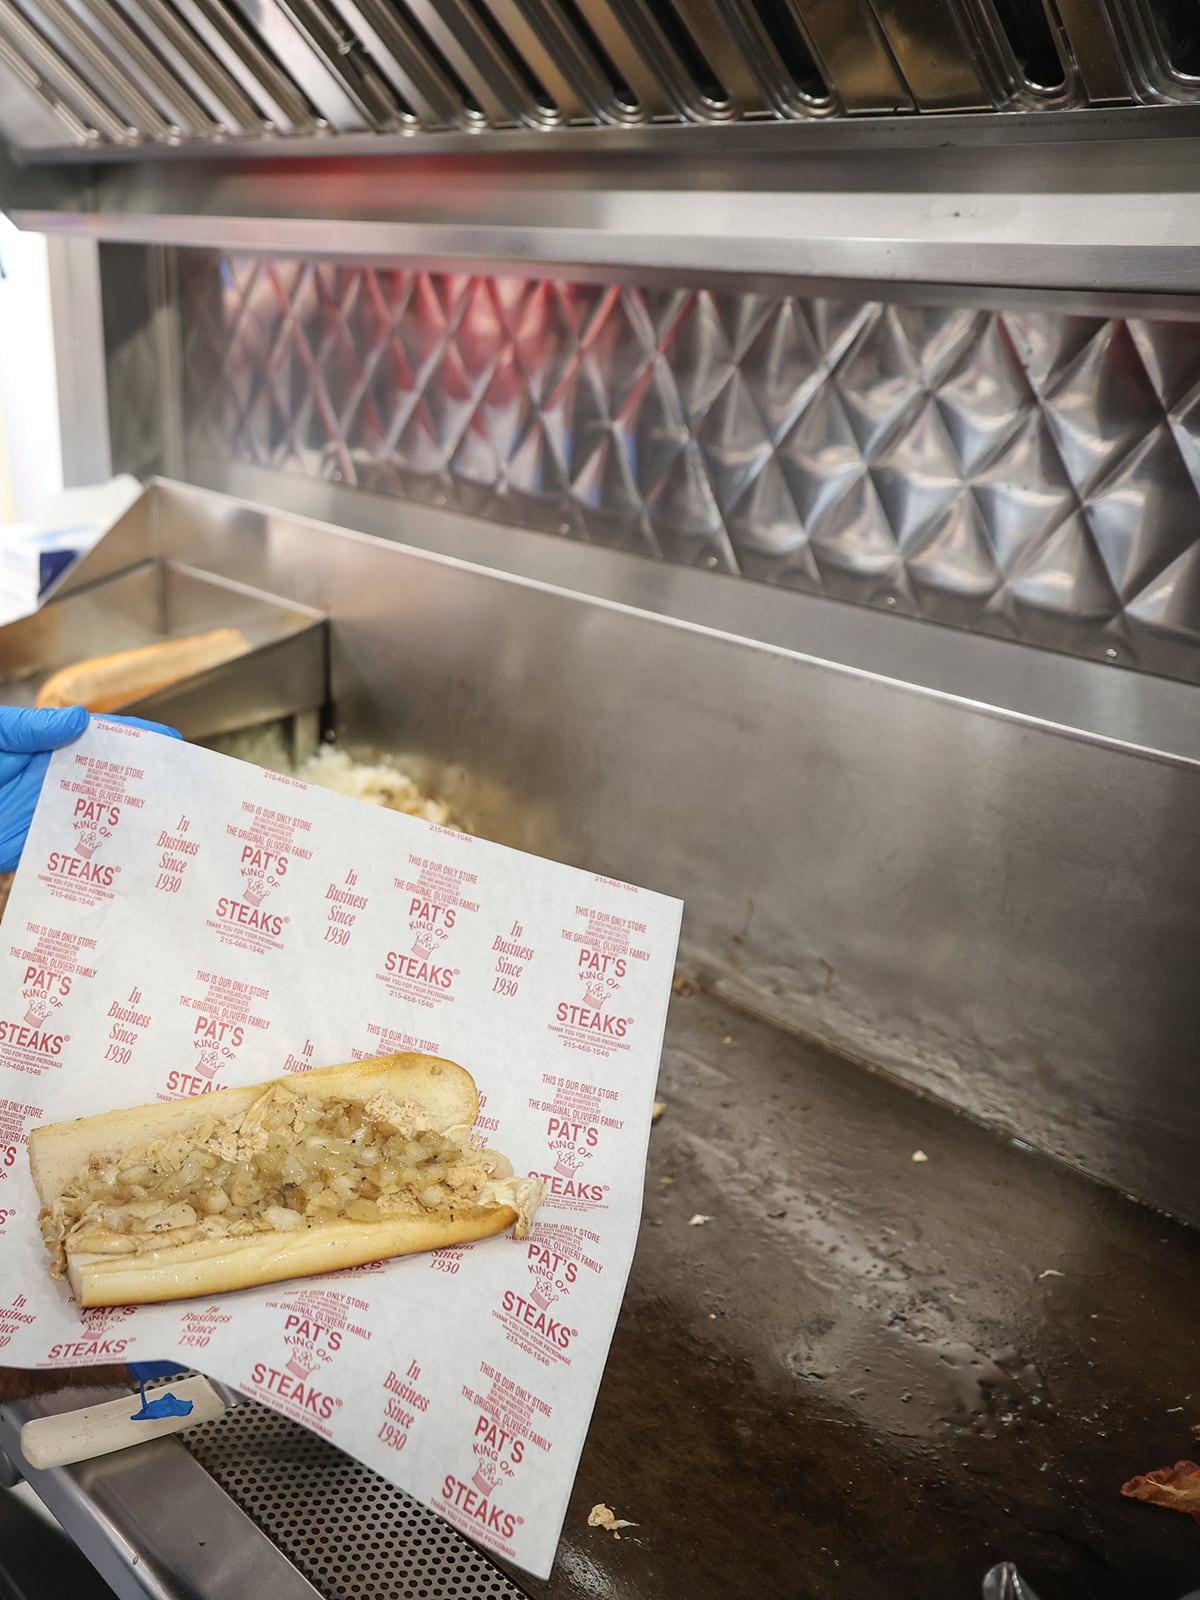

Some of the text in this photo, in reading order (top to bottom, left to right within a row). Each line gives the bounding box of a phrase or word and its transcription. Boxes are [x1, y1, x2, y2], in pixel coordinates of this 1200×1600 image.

[74, 798, 120, 826] PAT'S
[176, 814, 190, 832] In
[73, 821, 112, 839] KING OF
[156, 830, 200, 856] Business
[159, 852, 187, 873] Since
[241, 845, 288, 876] PAT'S
[409, 854, 422, 866] THIS
[422, 859, 429, 868] IS
[429, 861, 442, 872] OUR
[442, 865, 458, 877] ONLY
[458, 870, 479, 884] STORE
[154, 873, 182, 892] 1930
[241, 868, 280, 888] KING OF
[345, 869, 358, 886] In
[325, 883, 368, 910] Business
[394, 878, 406, 890] THE
[405, 882, 433, 898] ORIGINAL
[432, 890, 459, 906] OLIVIERI
[457, 898, 480, 912] FAMILY
[328, 905, 356, 926] Since
[409, 898, 456, 928] PAT'S
[26, 922, 97, 949] THIS IS OUR ONLY STORE
[323, 926, 351, 945] 1930
[409, 921, 449, 941] KING OF
[510, 920, 523, 937] In
[492, 935, 534, 960] Business
[10, 947, 22, 958] THE
[21, 950, 49, 965] ORIGINAL
[49, 958, 76, 972] OLIVIERI
[74, 964, 97, 978] FAMILY
[495, 956, 523, 977] Since
[579, 949, 627, 978] PAT'S
[24, 966, 72, 996] PAT'S
[196, 971, 270, 999] THIS IS OUR ONLY STORE
[492, 977, 518, 996] 1930
[579, 971, 621, 990] KING OF
[22, 989, 63, 1009] KING OF
[128, 986, 142, 1004] In
[107, 1001, 151, 1028] Business
[180, 996, 192, 1007] THE
[191, 999, 221, 1015] ORIGINAL
[220, 1007, 248, 1023] OLIVIERI
[246, 1015, 271, 1029] FAMILY
[109, 1022, 138, 1045] Since
[194, 1016, 244, 1047] PAT'S
[367, 1023, 440, 1053] THIS IS OUR ONLY STORE
[104, 1044, 132, 1064] 1930
[193, 1040, 236, 1059] KING OF
[302, 1039, 314, 1057] In
[542, 1074, 556, 1085] THIS
[557, 1078, 565, 1087] IS
[565, 1080, 579, 1091] OUR
[580, 1083, 596, 1095] ONLY
[597, 1087, 619, 1101] STORE
[7, 1100, 23, 1113] ONLY
[23, 1105, 44, 1119] STORE
[528, 1099, 541, 1109] THE
[541, 1102, 571, 1116] ORIGINAL
[571, 1109, 600, 1124] OLIVIERI
[599, 1116, 624, 1129] FAMILY
[547, 1118, 599, 1147] PAT'S
[548, 1140, 593, 1159] KING OF
[430, 1260, 460, 1274] 1930
[528, 1244, 578, 1283] PAT'S
[528, 1265, 569, 1295] KING OF
[12, 1294, 27, 1308] In
[327, 1292, 345, 1304] ONLY
[347, 1297, 370, 1311] STORE
[285, 1314, 343, 1351] PAT'S
[284, 1336, 334, 1363] KING OF
[406, 1359, 421, 1380] In
[383, 1370, 430, 1412] Business
[480, 1361, 494, 1379] THIS
[494, 1370, 502, 1384] IS
[501, 1375, 515, 1393] OUR
[515, 1384, 531, 1403] ONLY
[531, 1395, 553, 1417] STORE
[384, 1397, 415, 1429] Since
[462, 1385, 475, 1402] THE
[474, 1393, 503, 1420] ORIGINAL
[502, 1412, 530, 1438] OLIVIERI
[528, 1429, 552, 1452] FAMILY
[377, 1421, 407, 1450] 1930
[475, 1415, 524, 1464] PAT'S
[473, 1444, 515, 1478] KING OF
